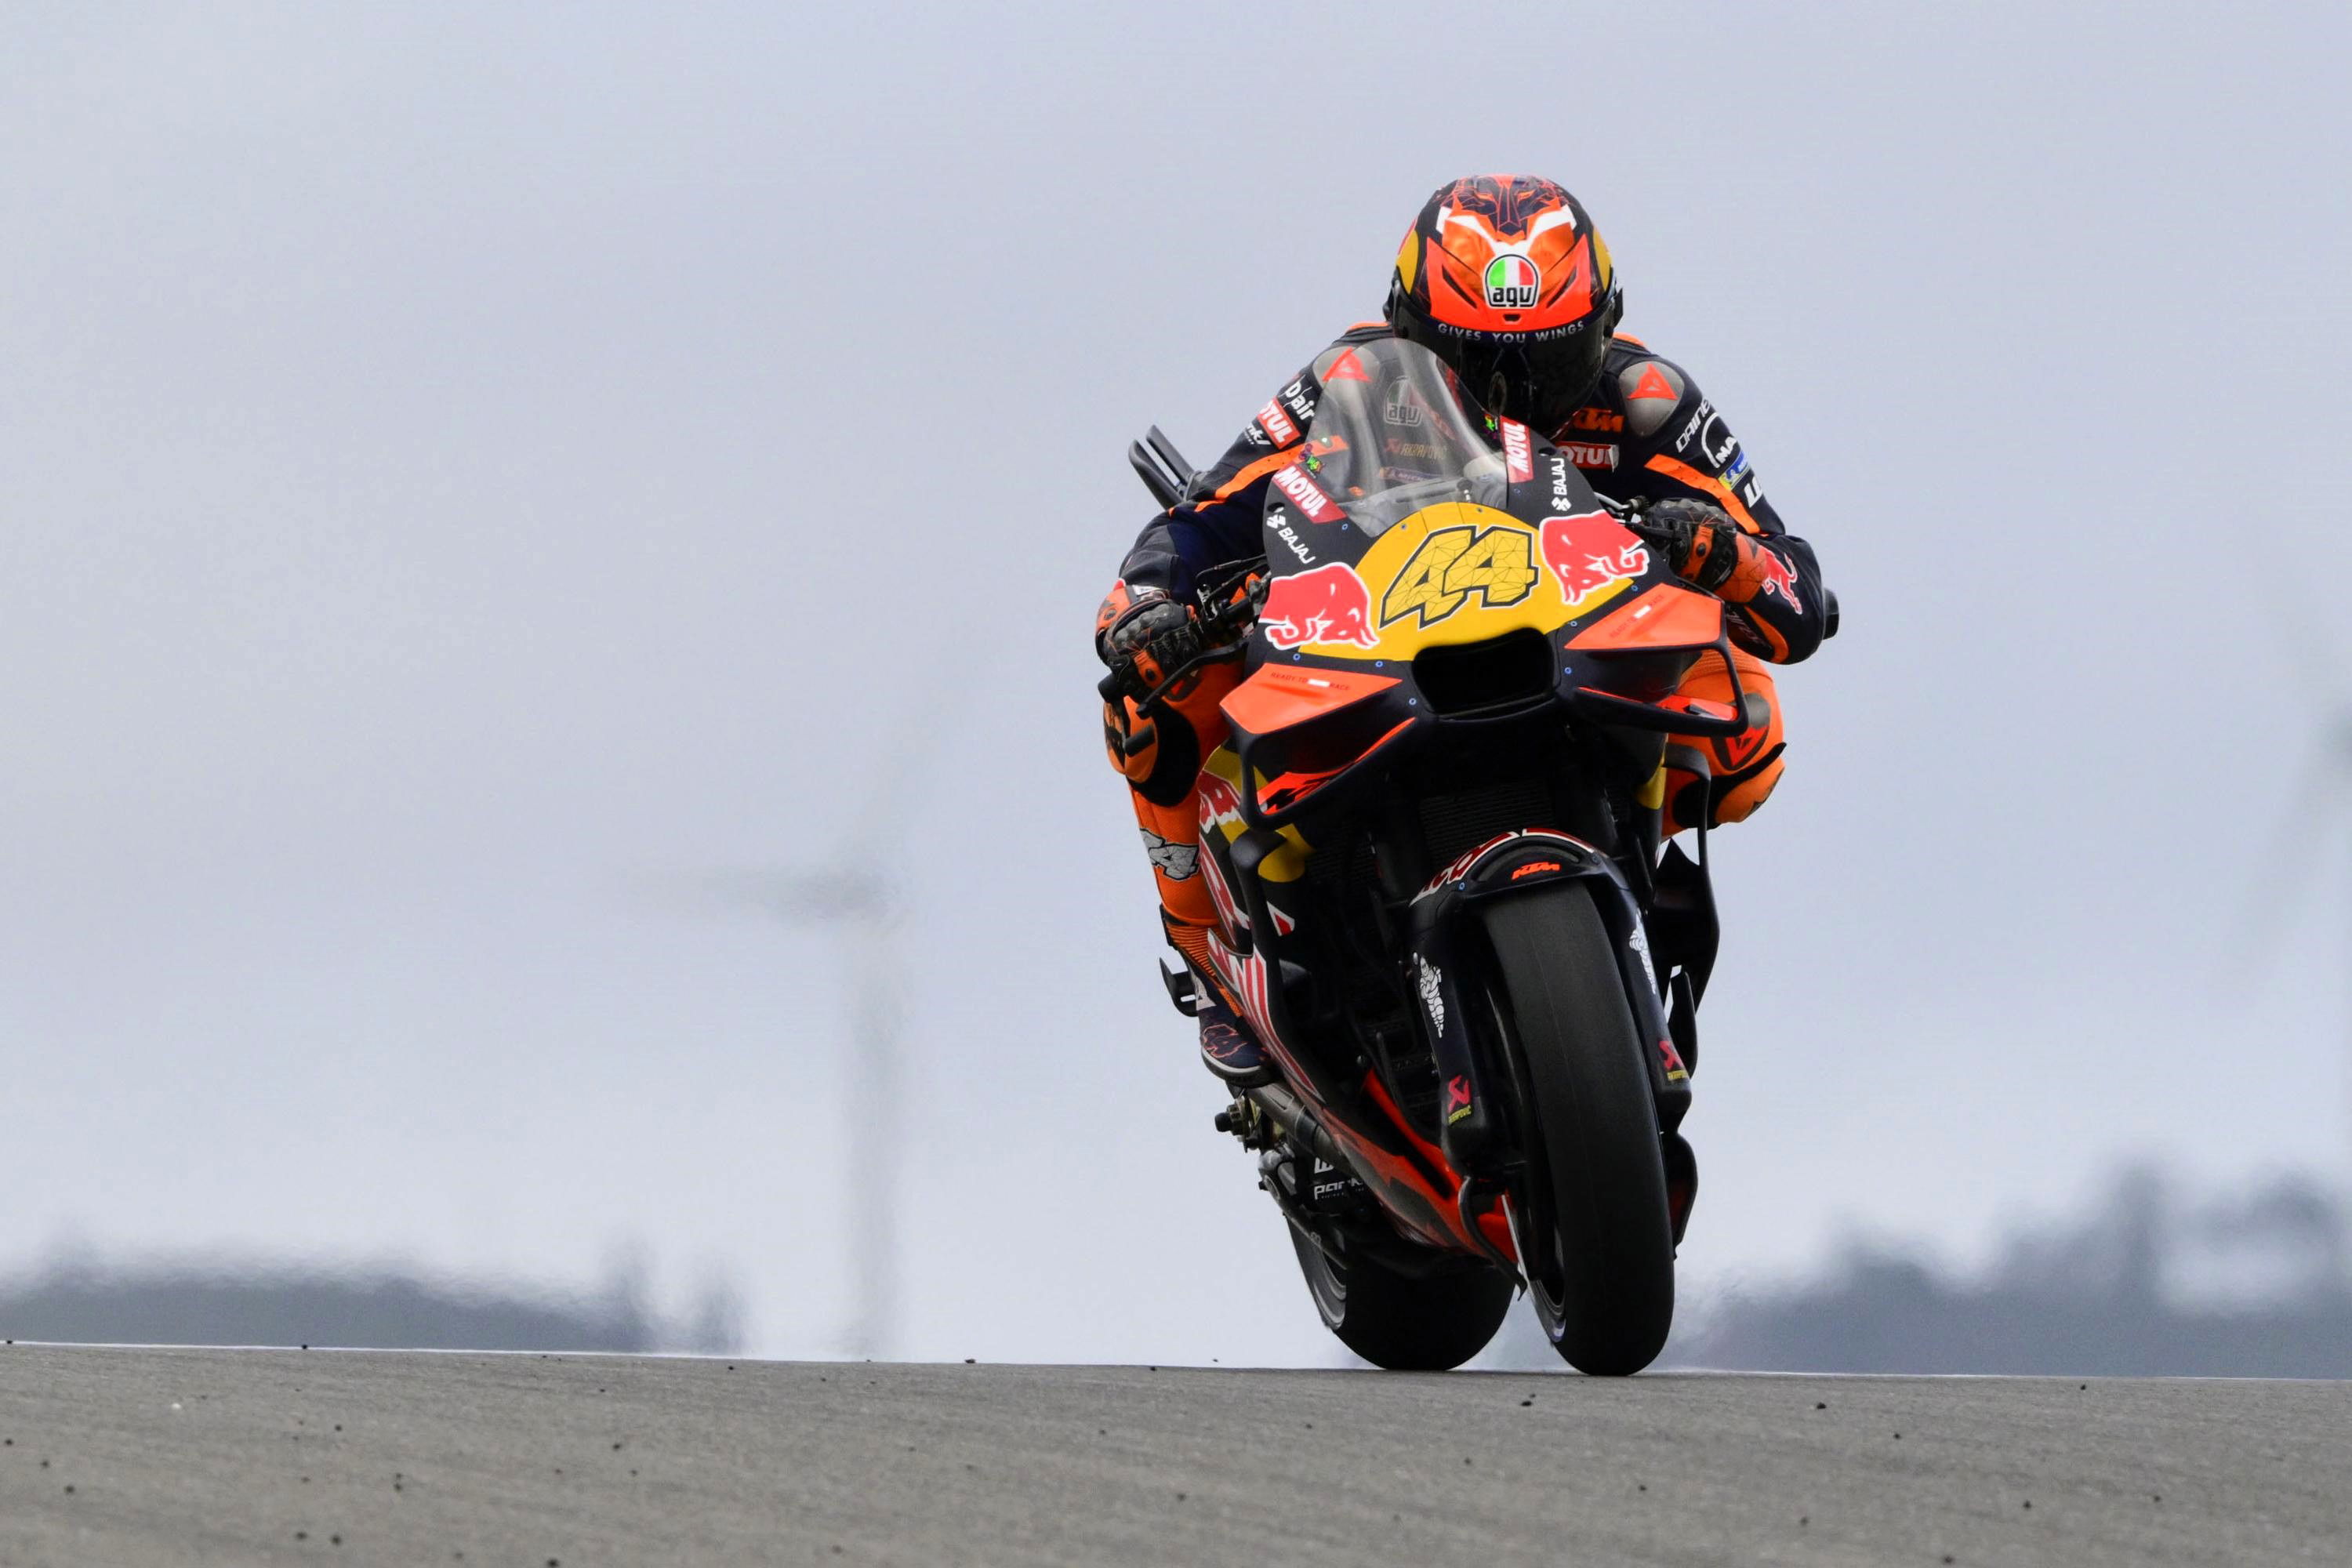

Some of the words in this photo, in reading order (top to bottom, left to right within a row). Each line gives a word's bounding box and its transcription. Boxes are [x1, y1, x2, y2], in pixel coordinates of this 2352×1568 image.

[1493, 287, 1532, 307] agv
[1438, 323, 1481, 340] GIVES
[1492, 332, 1526, 343] YOU
[1535, 320, 1584, 342] WINGS
[1503, 422, 1530, 474] MOTUL
[1273, 466, 1327, 517] MOTUL
[1550, 458, 1567, 495] BAJAJ
[1278, 527, 1316, 564] BAJAJ
[1378, 525, 1539, 630] 44
[1271, 672, 1296, 681] READY
[1512, 861, 1560, 881] KTM
